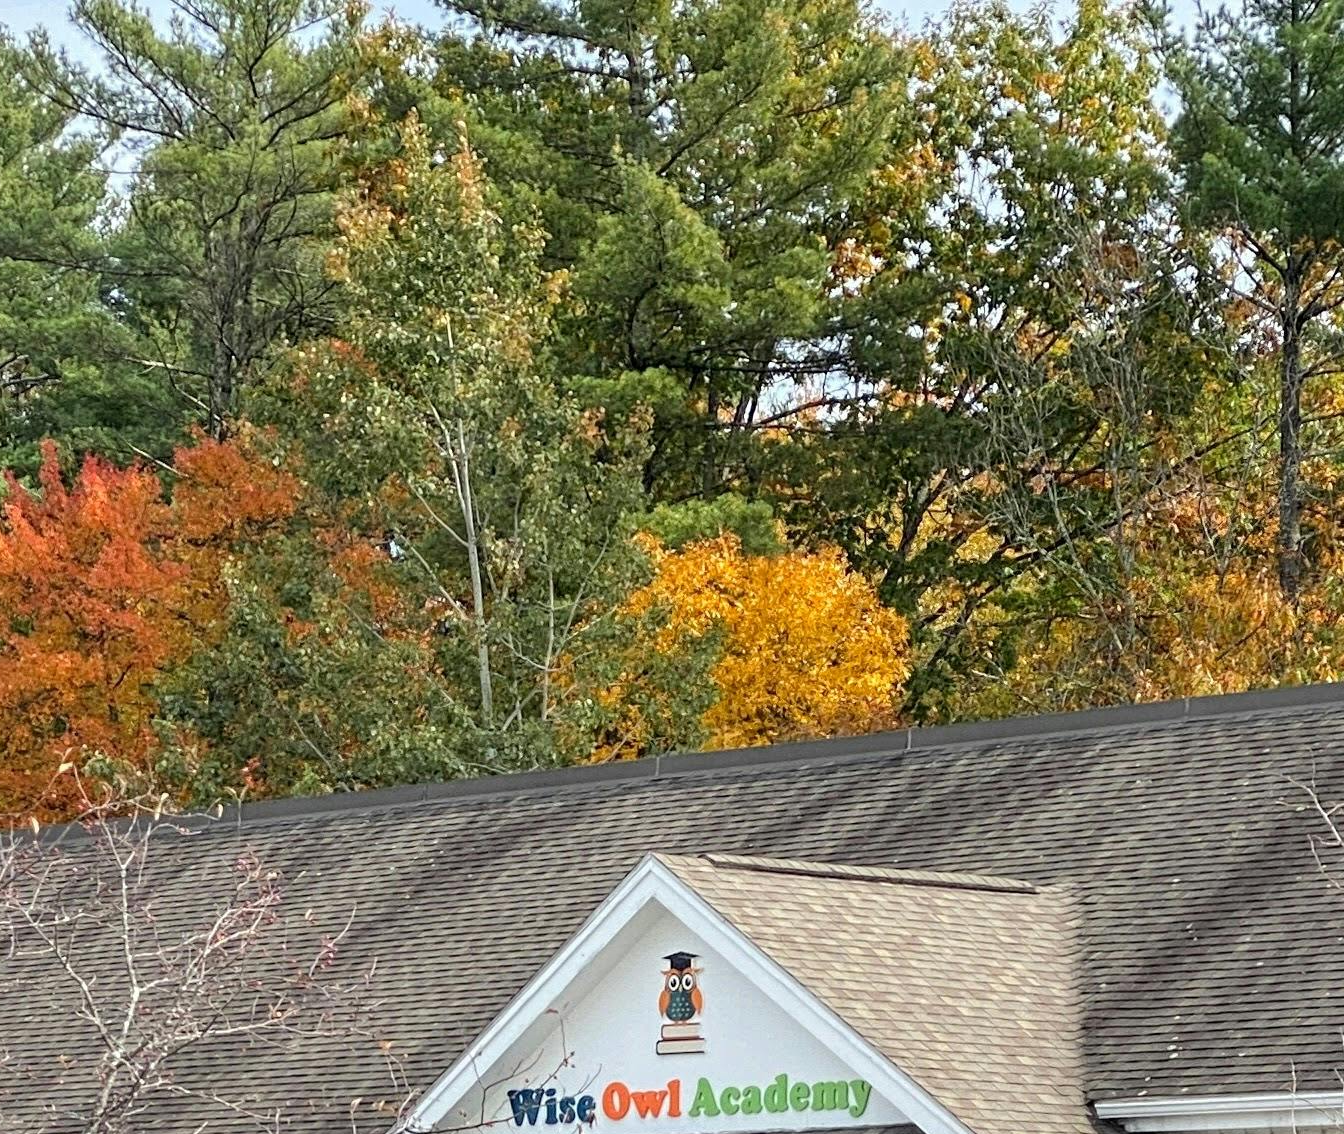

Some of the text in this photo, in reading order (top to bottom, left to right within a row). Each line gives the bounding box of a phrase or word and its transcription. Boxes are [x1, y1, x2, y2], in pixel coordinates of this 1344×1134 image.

[507, 1073, 872, 1127] Wise Owl Academy
